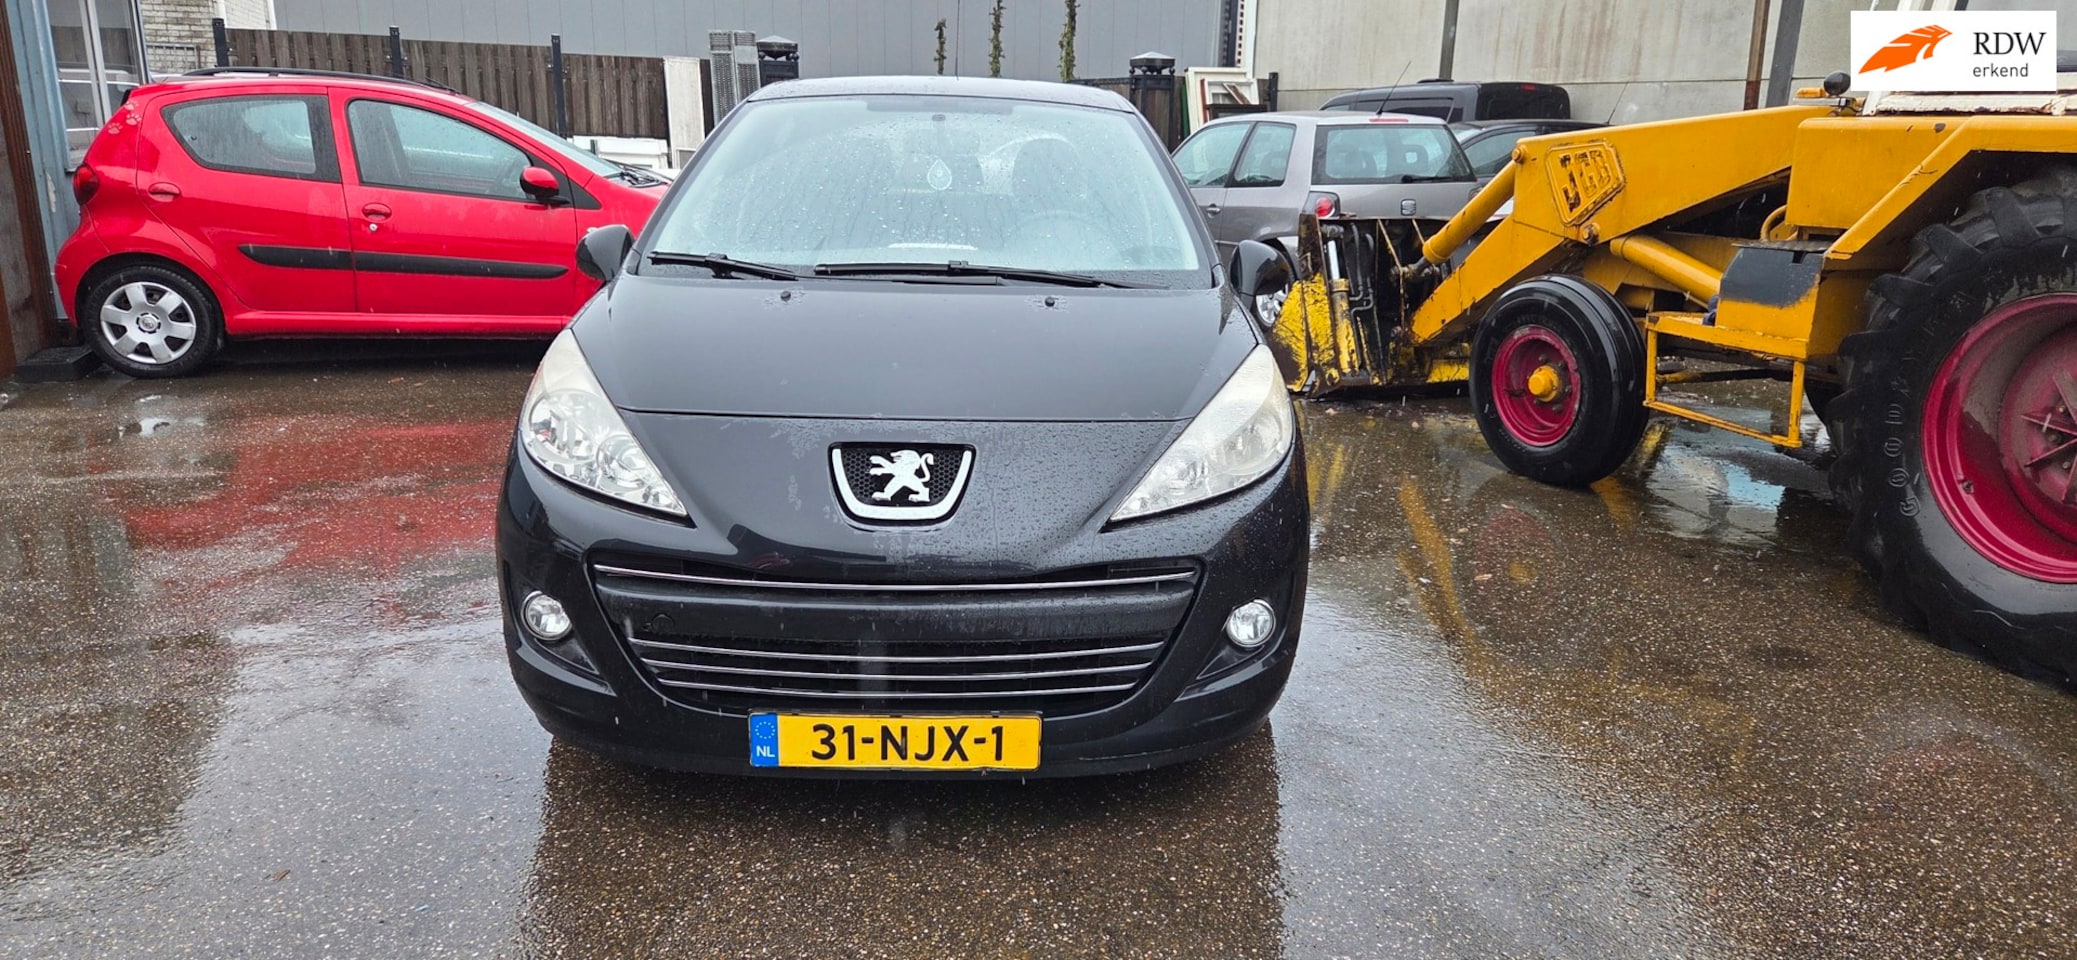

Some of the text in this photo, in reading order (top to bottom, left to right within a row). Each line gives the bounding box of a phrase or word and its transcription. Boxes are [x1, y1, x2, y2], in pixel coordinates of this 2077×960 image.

[1559, 148, 1612, 214] JCB
[756, 746, 775, 758] NL
[811, 723, 1004, 762] 31-NJX-1
